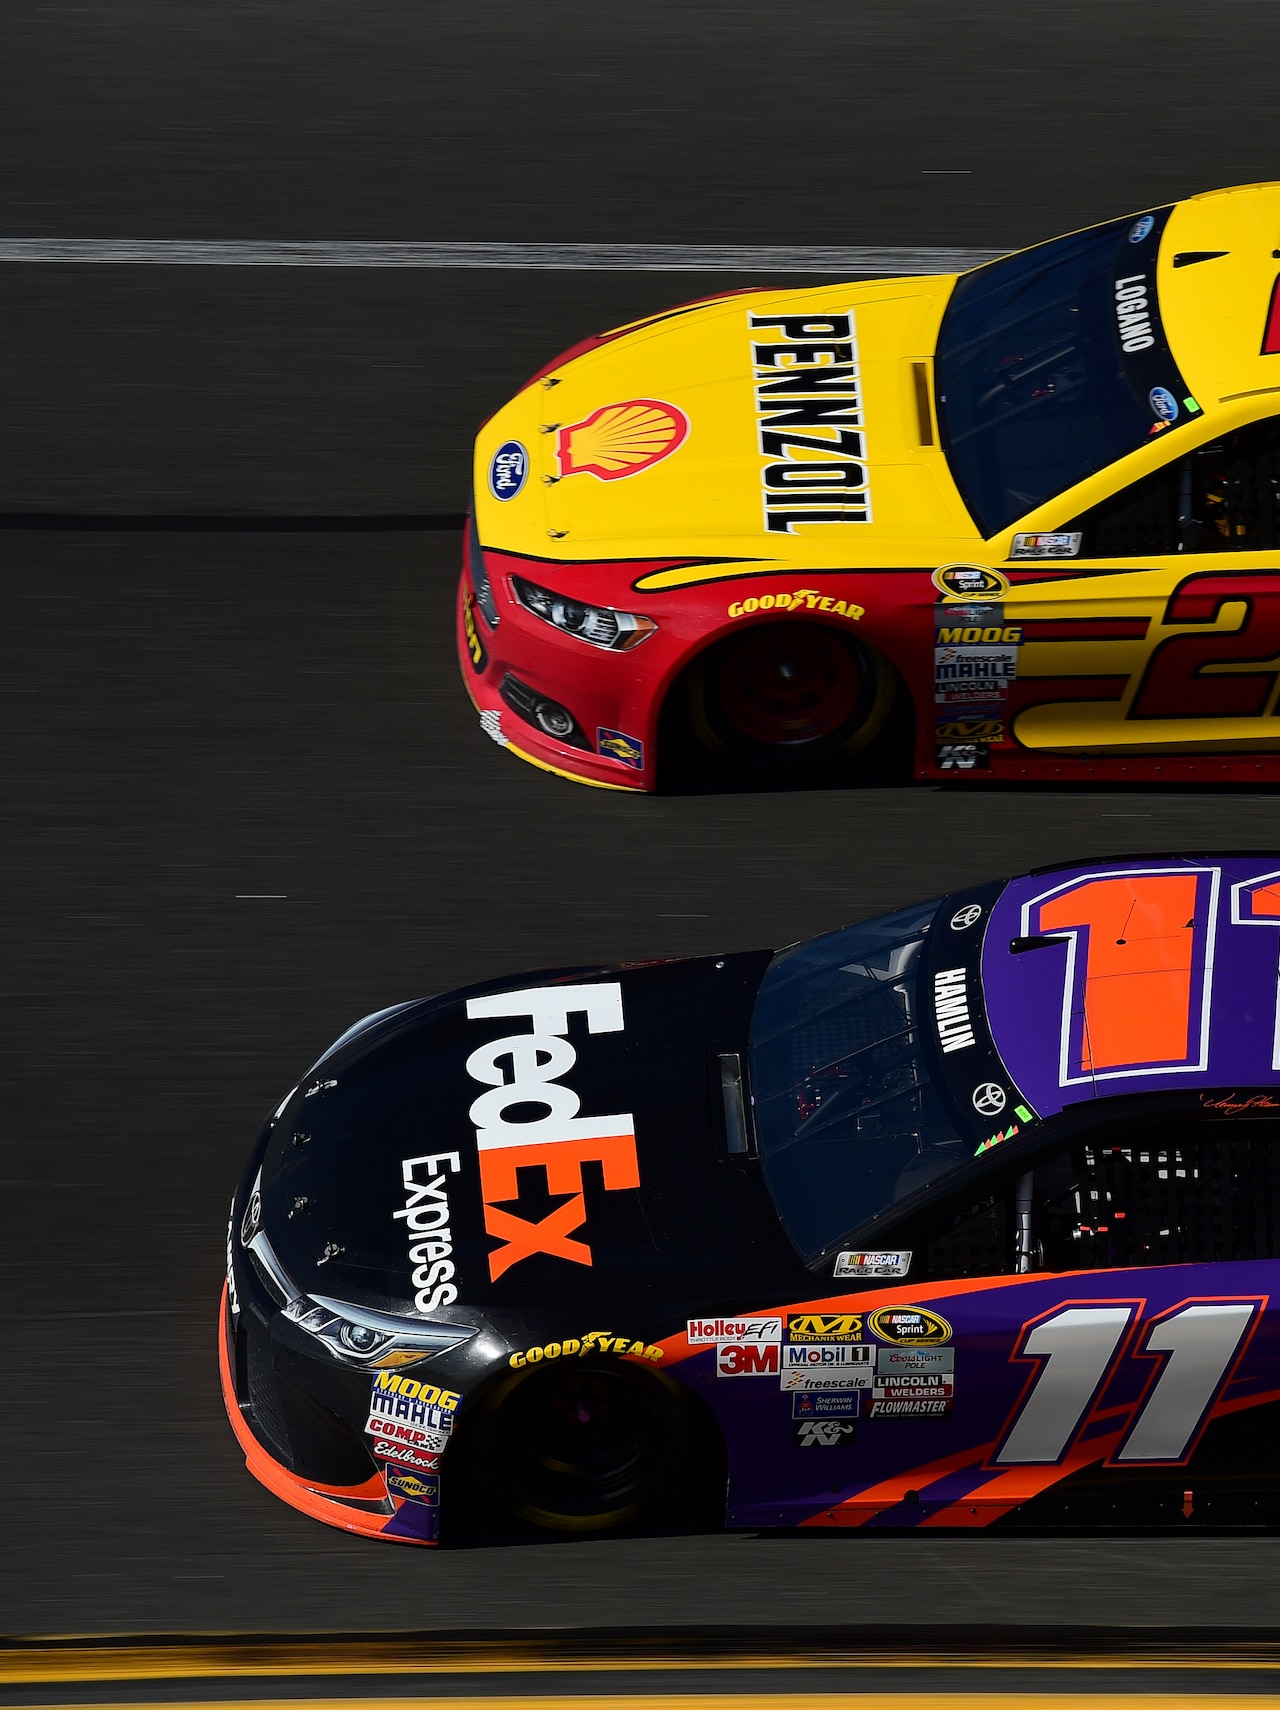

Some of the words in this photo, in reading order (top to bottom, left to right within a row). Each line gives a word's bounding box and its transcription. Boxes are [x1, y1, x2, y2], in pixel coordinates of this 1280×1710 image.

[1132, 220, 1151, 239] Ford
[1114, 274, 1155, 352] LOGANO
[1152, 388, 1175, 418] Ford
[747, 308, 873, 536] PENNZOIL
[495, 451, 525, 491] Ford
[958, 579, 985, 590] Sprint
[936, 626, 1023, 644] MOOG
[955, 653, 1012, 663] freescale
[936, 663, 1016, 680] MAHLE
[938, 680, 995, 692] LINCOLN
[950, 691, 1000, 700] WELDERS
[934, 967, 976, 1054] HAMLIN
[466, 982, 641, 1284] FedEx
[392, 1151, 461, 1314] Express
[862, 1254, 898, 1265] NASCAR
[874, 1267, 903, 1275] CAR
[890, 1314, 922, 1325] NASCAR
[689, 1319, 746, 1341] Holley
[744, 1320, 779, 1339] EFI
[789, 1332, 835, 1342] MECHANIX
[836, 1332, 863, 1342] WEAR
[896, 1324, 924, 1336] Sprint
[719, 1345, 778, 1375] 3M
[789, 1346, 845, 1363] Mobil
[889, 1353, 916, 1363] Coors
[804, 1377, 866, 1389] freescale
[877, 1375, 940, 1388] LINCOLN
[984, 1297, 1266, 1469] 11
[373, 1371, 461, 1412] MOOG
[815, 1396, 853, 1404] SHERWIN
[890, 1387, 946, 1397] WELDERS
[372, 1392, 453, 1431] MAHLE
[815, 1404, 853, 1412] WILLIAMS
[869, 1400, 947, 1418] FLOWMASTER
[369, 1419, 426, 1443] COMP
[407, 1439, 435, 1451] CAMS
[374, 1441, 440, 1470] Edelbrock
[389, 1476, 437, 1496] SUNOCO
